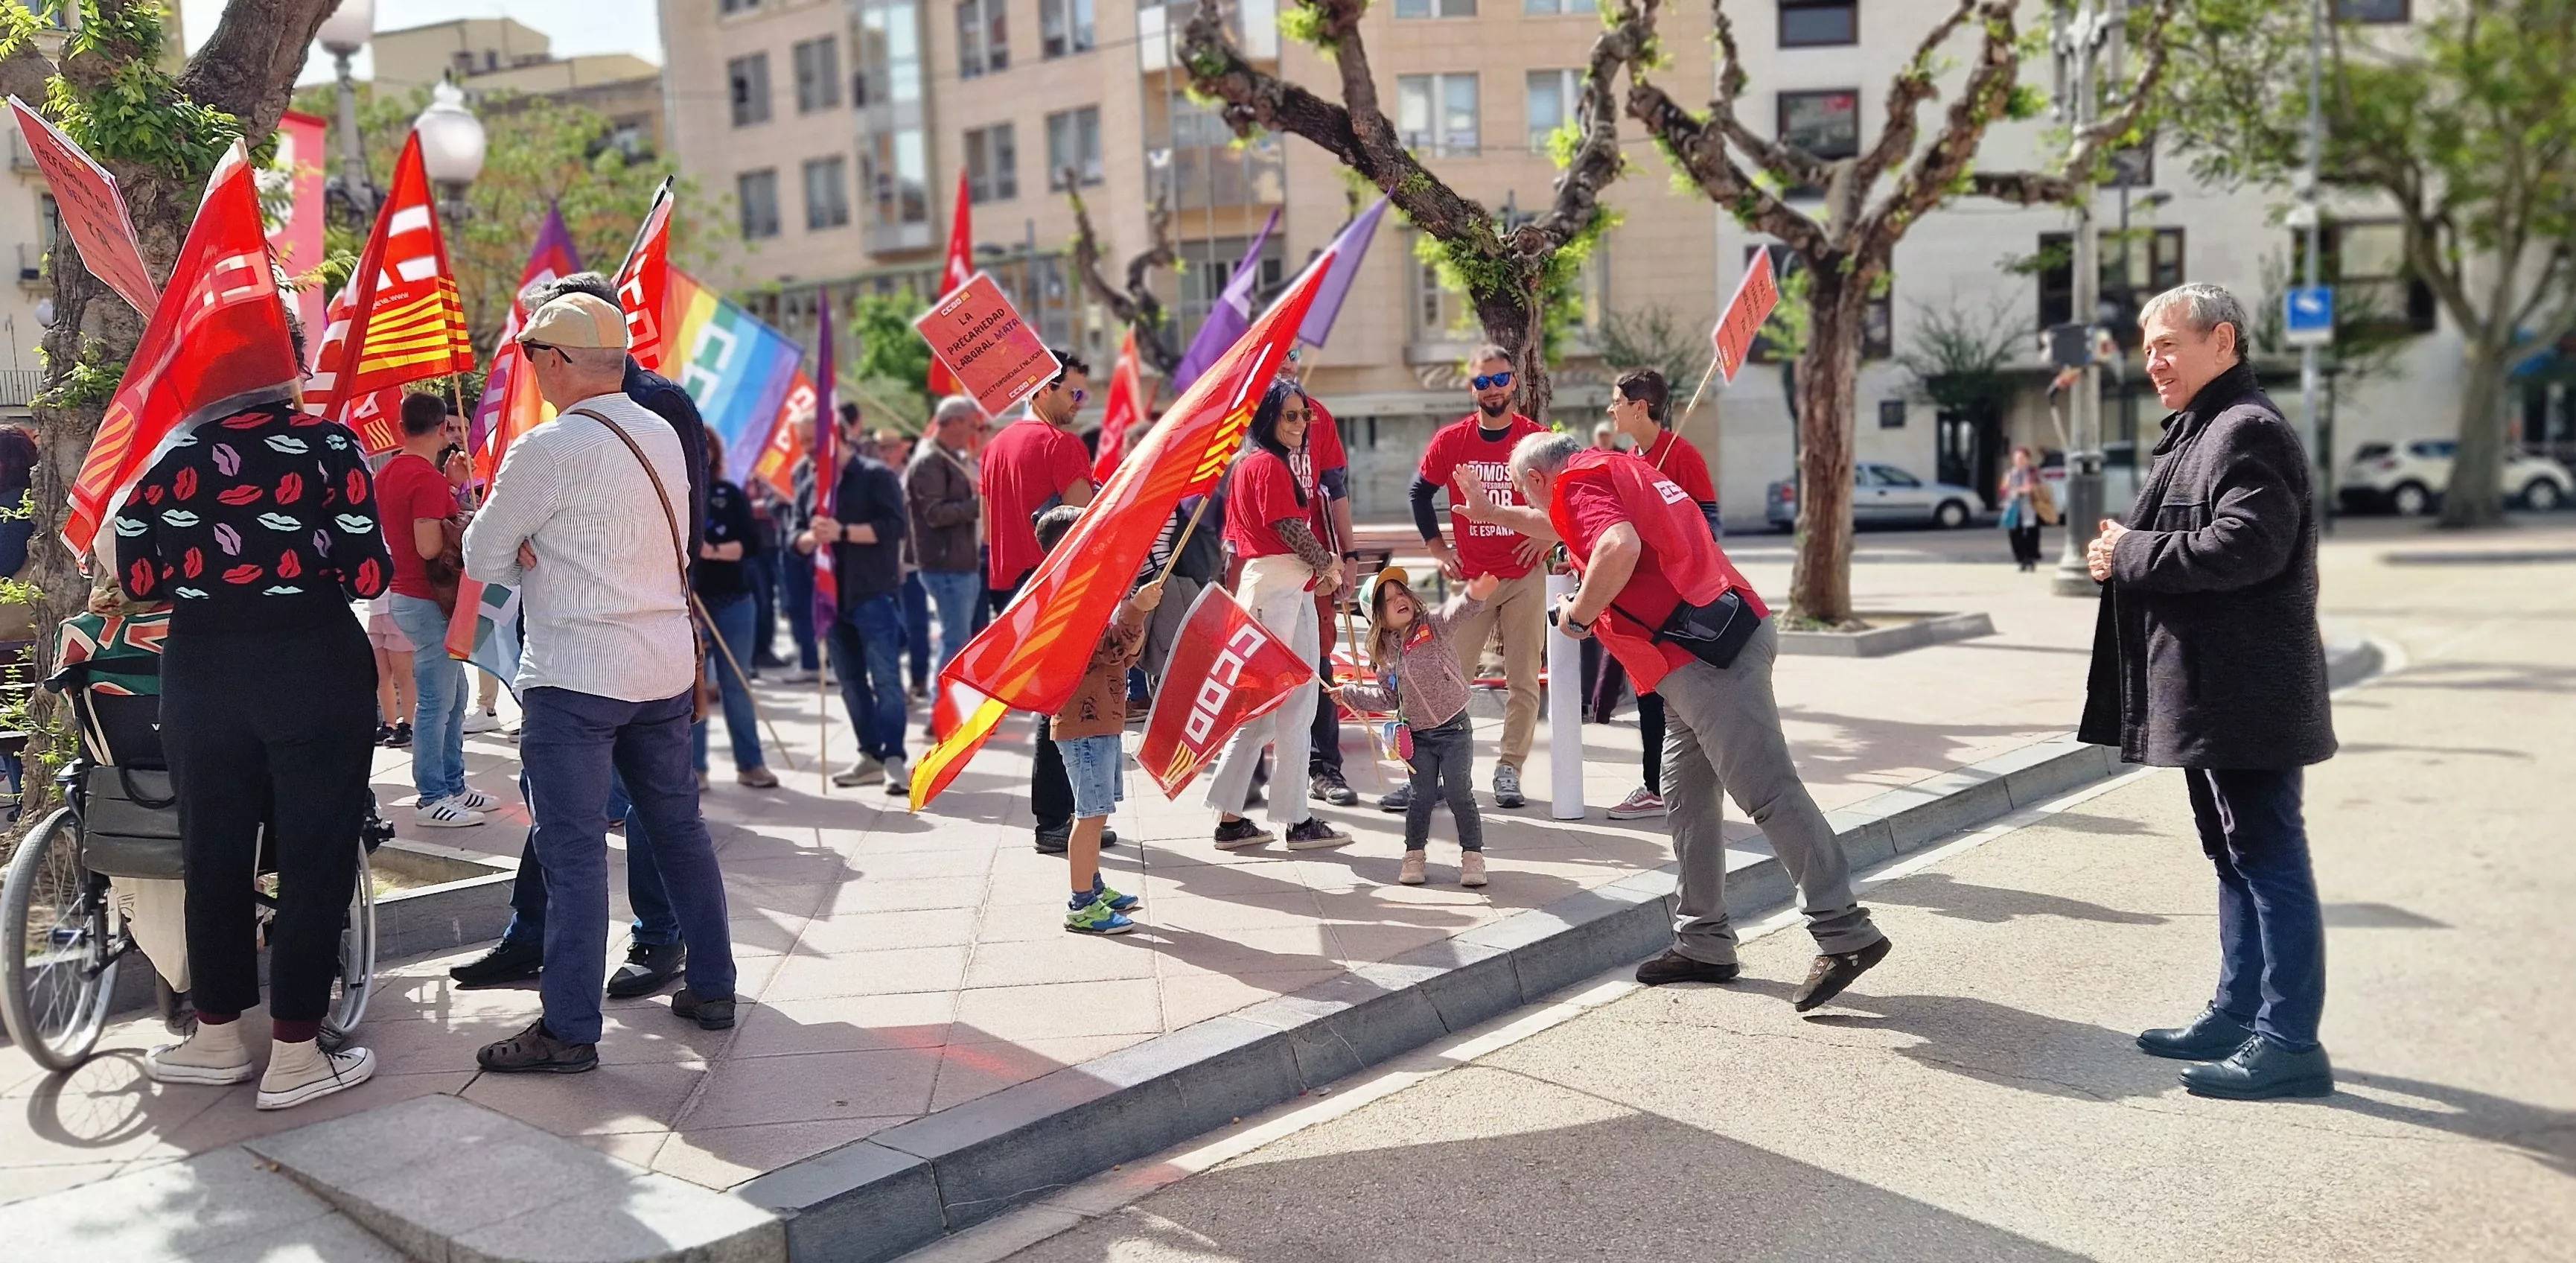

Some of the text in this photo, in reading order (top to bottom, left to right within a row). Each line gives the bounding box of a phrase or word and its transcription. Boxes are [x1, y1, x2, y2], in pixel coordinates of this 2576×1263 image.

[941, 298, 963, 316] CCOO
[957, 312, 974, 326] LA
[946, 308, 1005, 356] PRECARIEDAD
[953, 318, 1021, 372] LABORAL MATA
[1008, 381, 1030, 399] CCOO
[1185, 623, 1267, 745] CCOO
